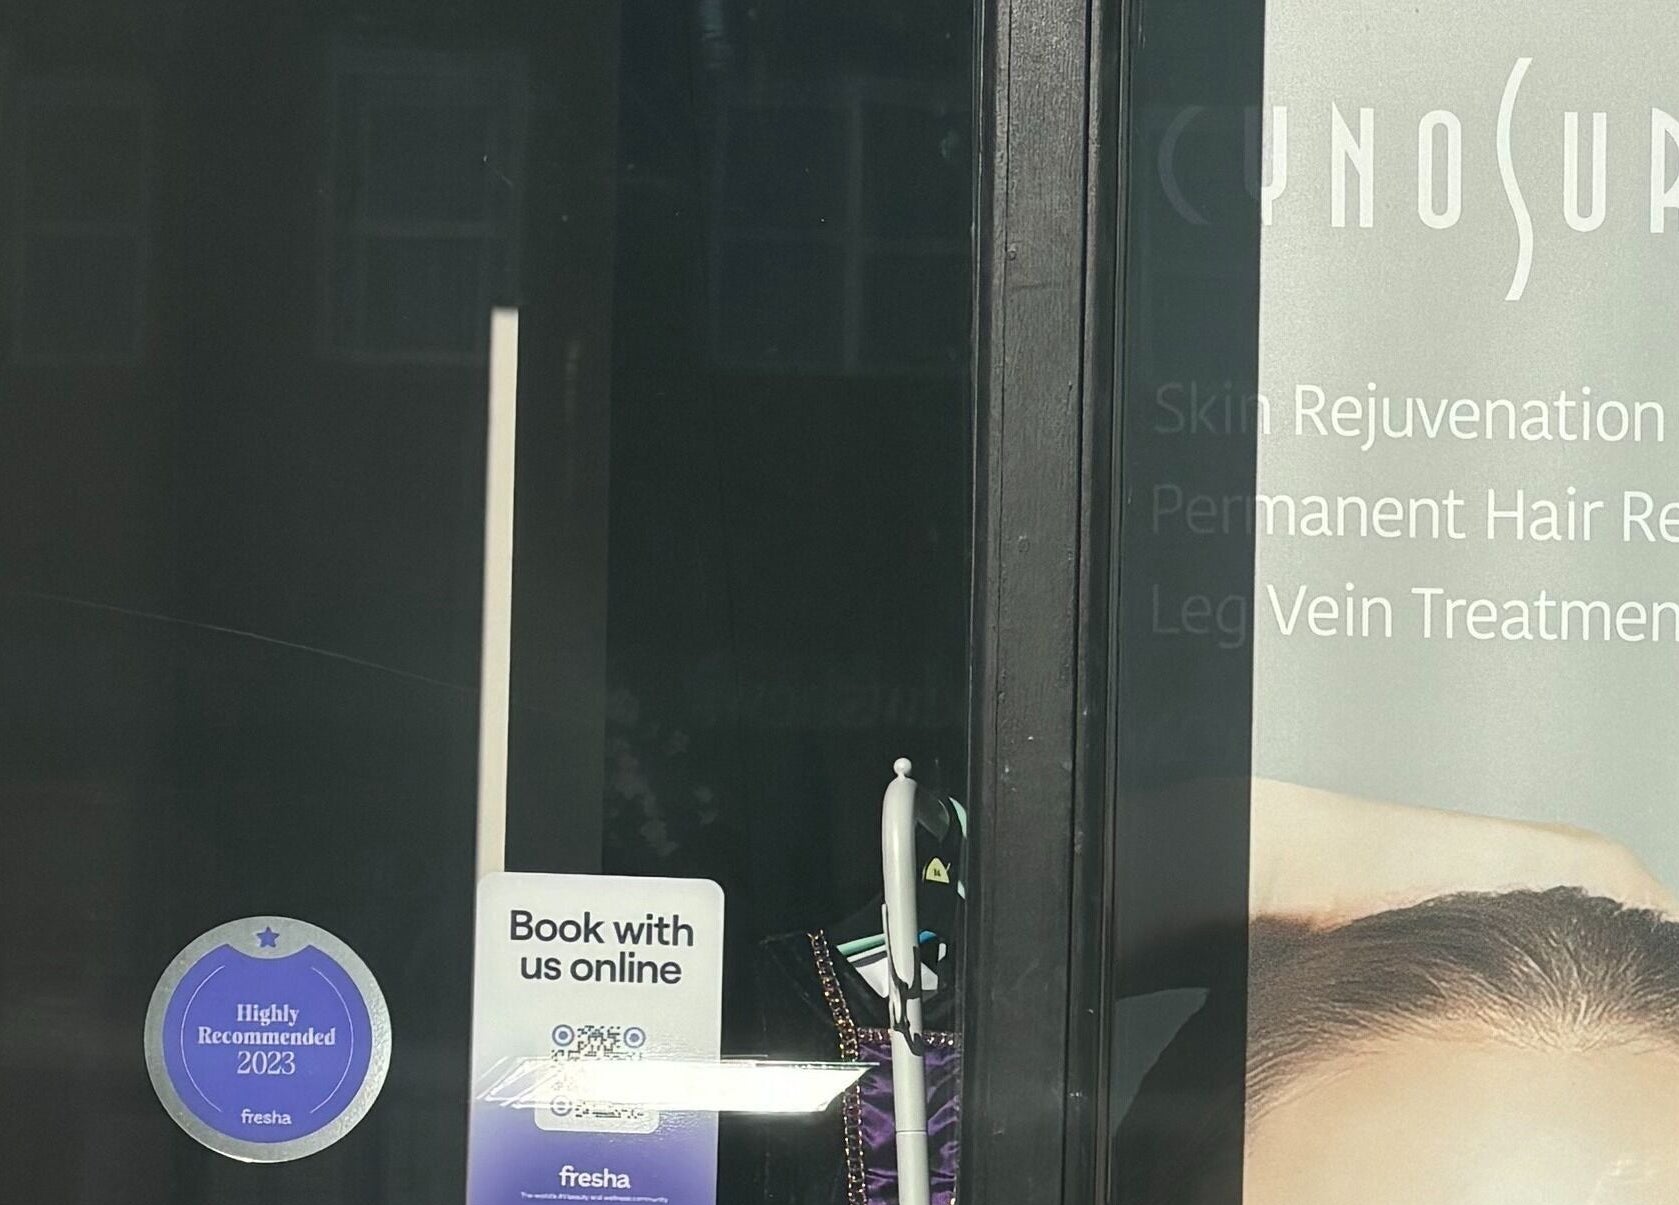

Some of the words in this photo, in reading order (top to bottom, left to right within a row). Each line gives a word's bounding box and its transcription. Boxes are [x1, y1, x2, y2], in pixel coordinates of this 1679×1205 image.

[1153, 383, 1271, 436] Skin
[1293, 384, 1665, 450] Rejuvenation
[1151, 485, 1467, 541] Permanent
[1485, 487, 1604, 543] Hair
[1151, 587, 1248, 648] Leg
[1265, 584, 1394, 638] Vein
[510, 909, 606, 944] Book
[613, 913, 694, 947] with
[520, 956, 562, 981] us
[570, 951, 682, 985] online
[236, 1003, 300, 1027] Highly
[198, 1026, 337, 1046] Recommended
[236, 1050, 296, 1075] 2023
[241, 1108, 293, 1125] fresha
[558, 1164, 632, 1189] fresha
